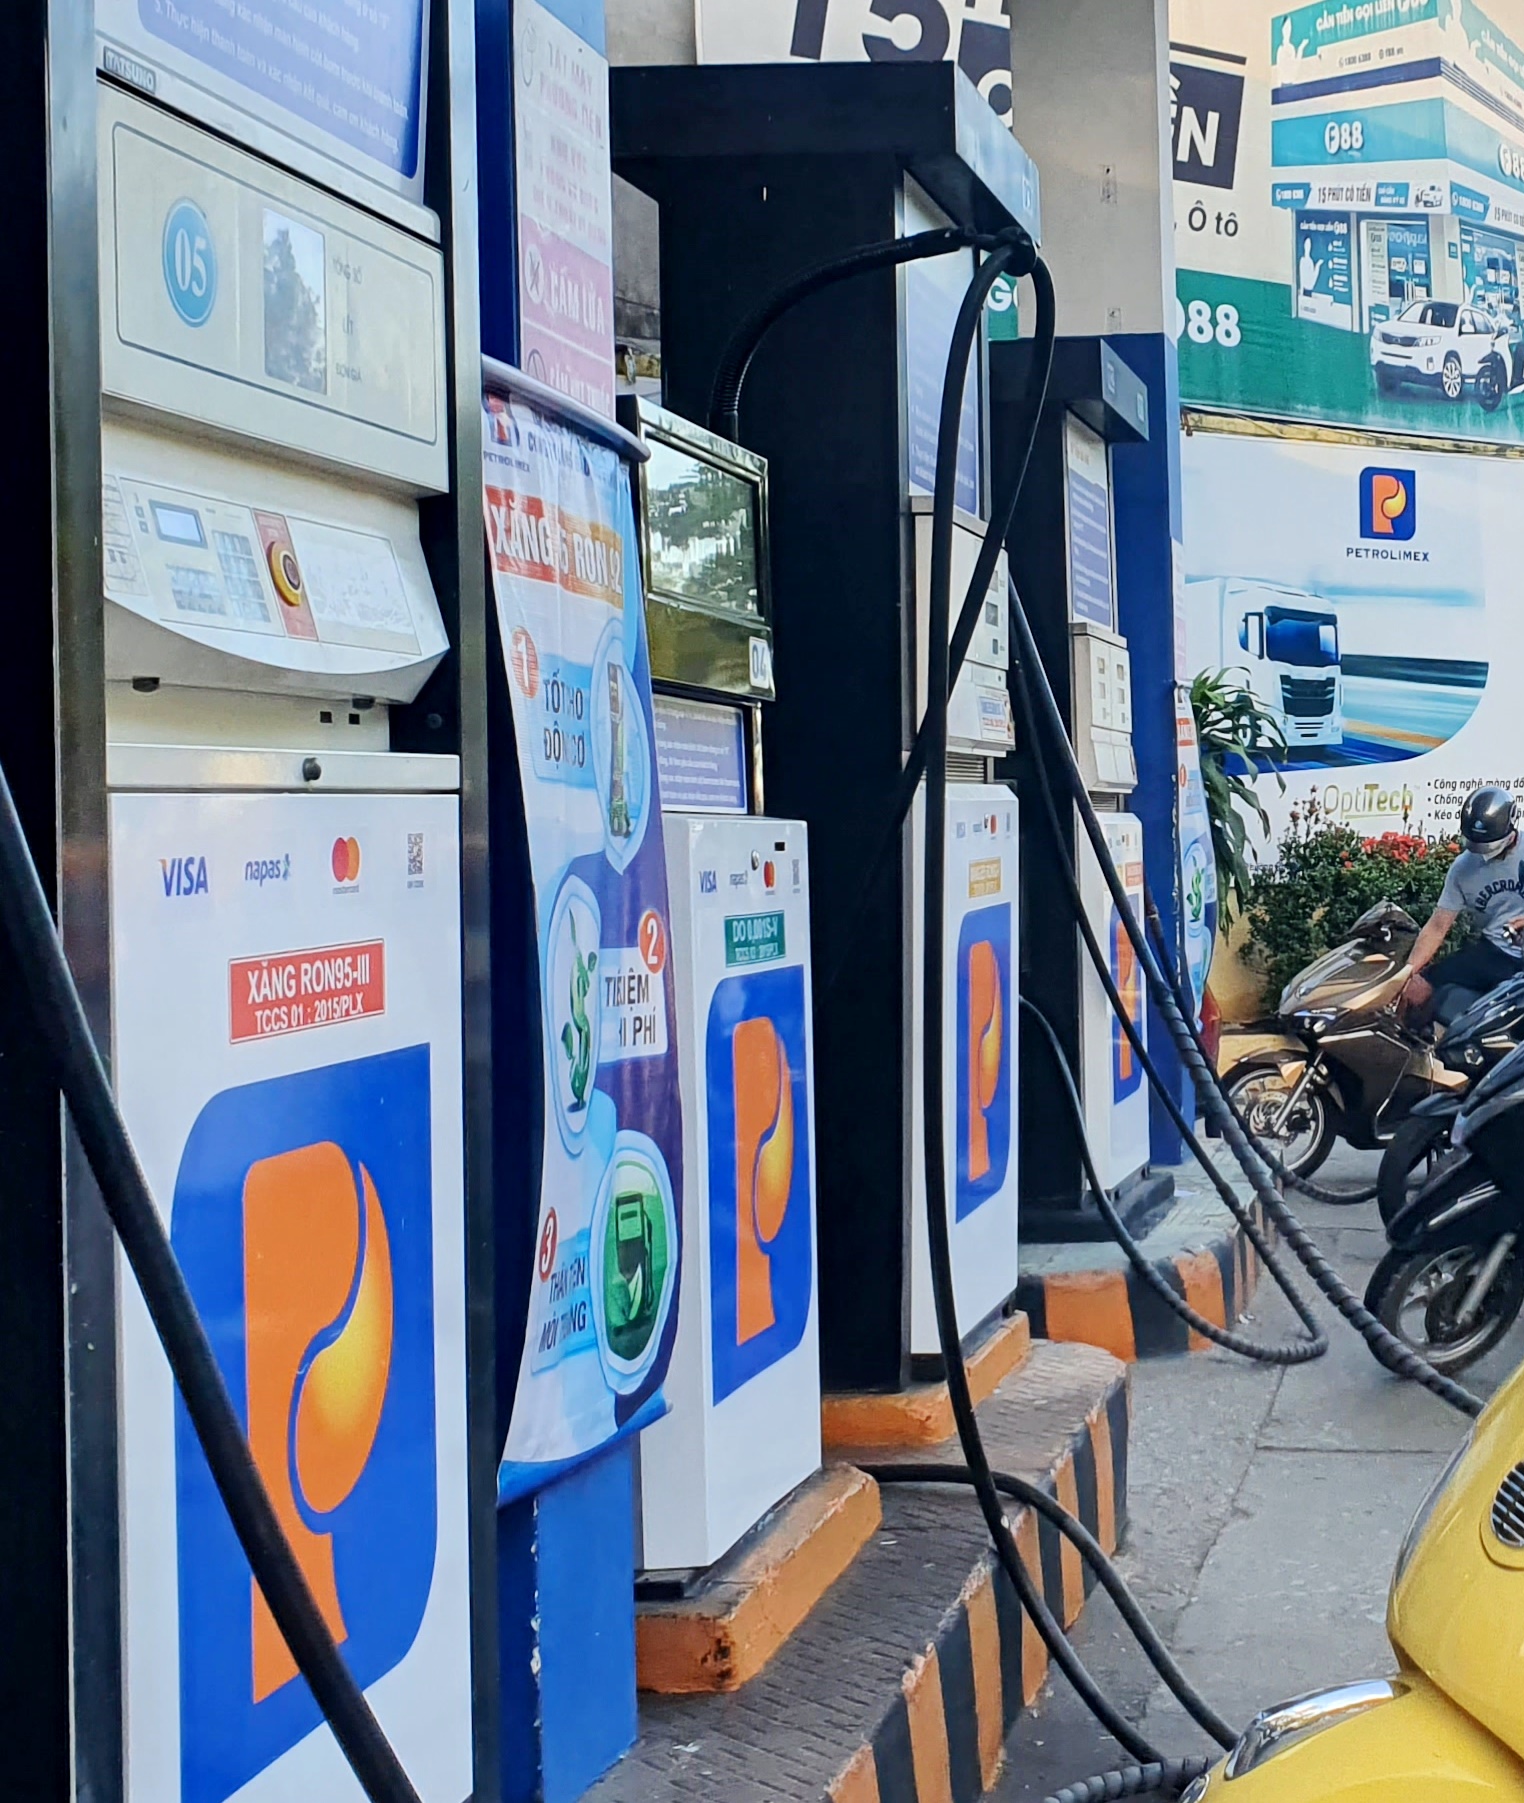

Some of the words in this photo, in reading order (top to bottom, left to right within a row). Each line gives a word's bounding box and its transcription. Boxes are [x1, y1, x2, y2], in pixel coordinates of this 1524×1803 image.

[105, 52, 155, 89] TATSUNO
[1214, 209, 1239, 238] tô
[174, 227, 208, 297] 05
[490, 498, 554, 568] XĂNG
[572, 532, 609, 588] RON
[1345, 546, 1430, 563] PETROLIMEX
[751, 645, 768, 687] 04
[1322, 783, 1414, 819] OptiTech
[1433, 778, 1457, 791] Công
[1434, 793, 1464, 807] Chống
[1434, 809, 1453, 820] Kéo
[158, 855, 209, 898] VISA
[244, 857, 282, 888] napas
[698, 869, 718, 894] VISA
[646, 917, 659, 965] 2
[732, 919, 747, 943] DO
[247, 960, 297, 1005] XĂNG
[300, 952, 371, 997] RON95-III
[254, 1004, 289, 1035] TCCS
[290, 1002, 305, 1028] 01
[313, 991, 365, 1023] 2015/PLX
[631, 1007, 657, 1047] PHÍ
[541, 1216, 555, 1275] 3
